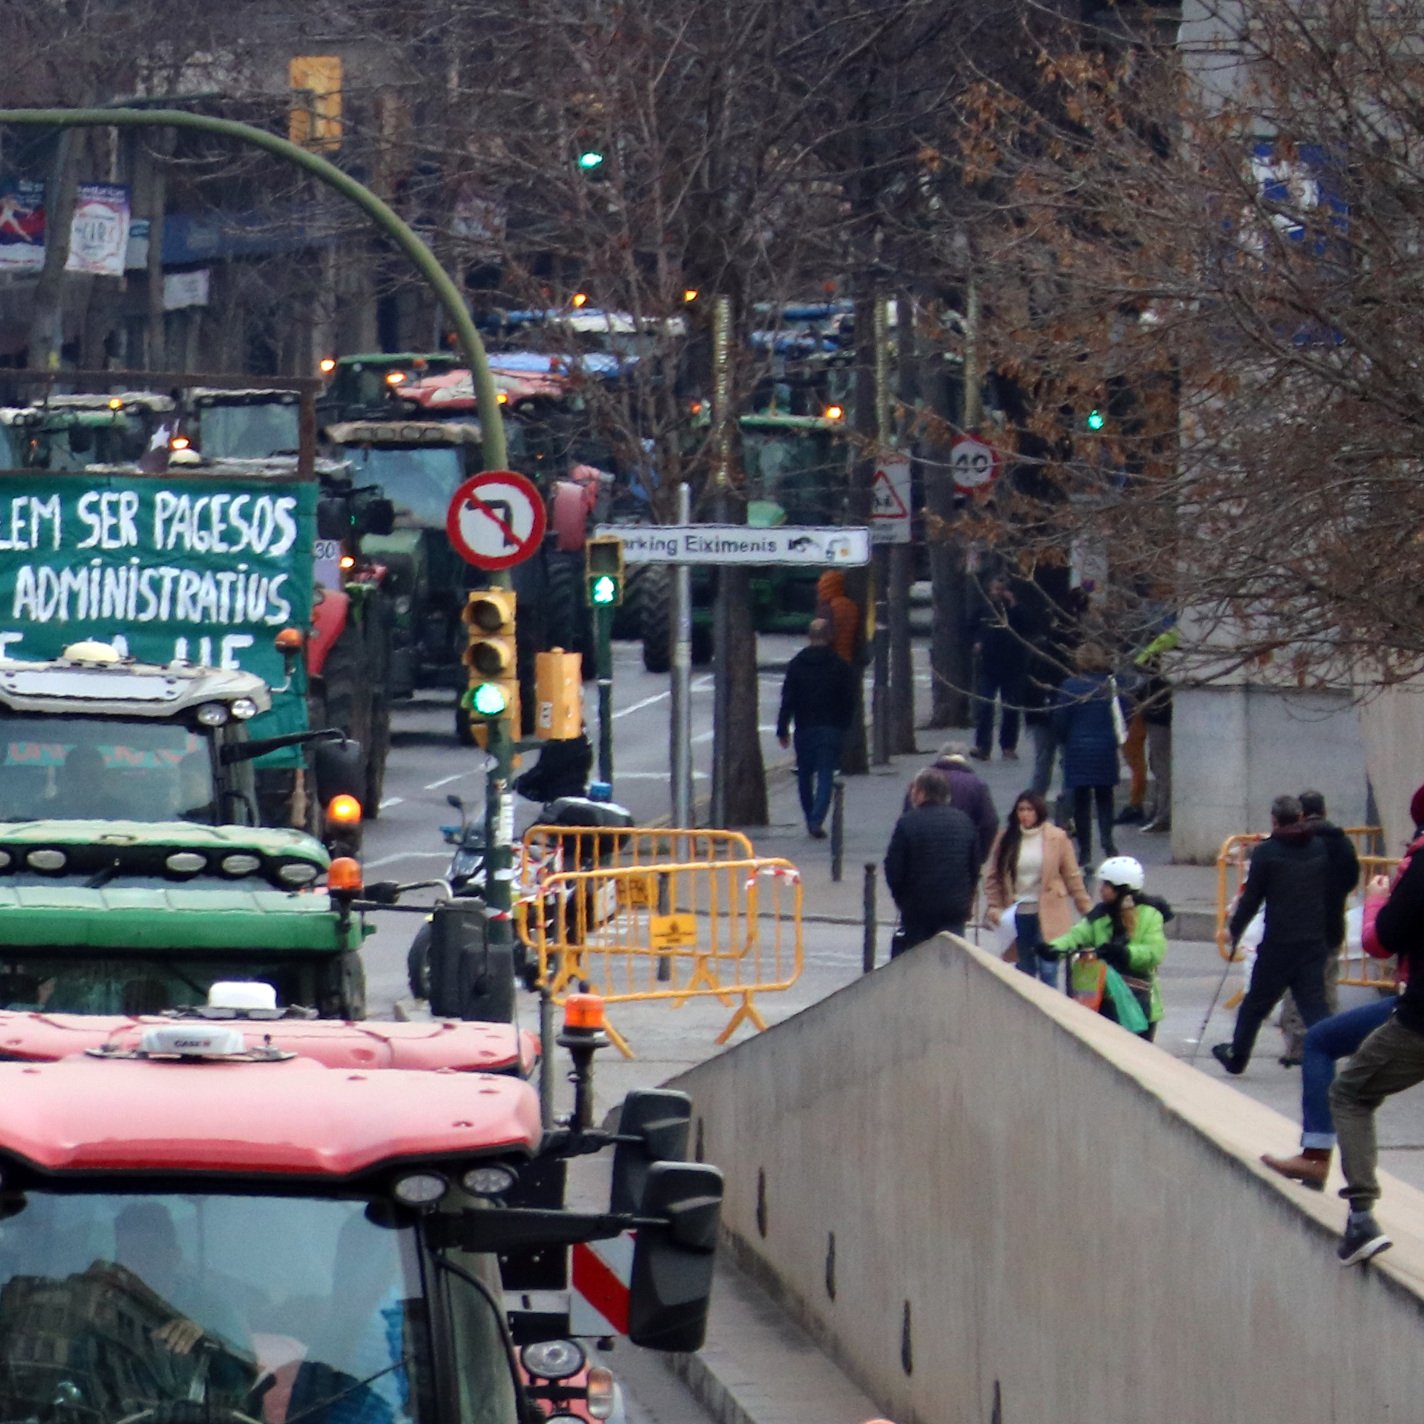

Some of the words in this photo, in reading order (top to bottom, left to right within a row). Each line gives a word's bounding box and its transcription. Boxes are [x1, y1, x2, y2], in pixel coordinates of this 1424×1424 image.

[955, 454, 988, 473] 40
[77, 491, 138, 550] SER
[155, 491, 297, 556] PAGESOS
[620, 535, 678, 556] arking
[685, 535, 778, 554] Eiximenis
